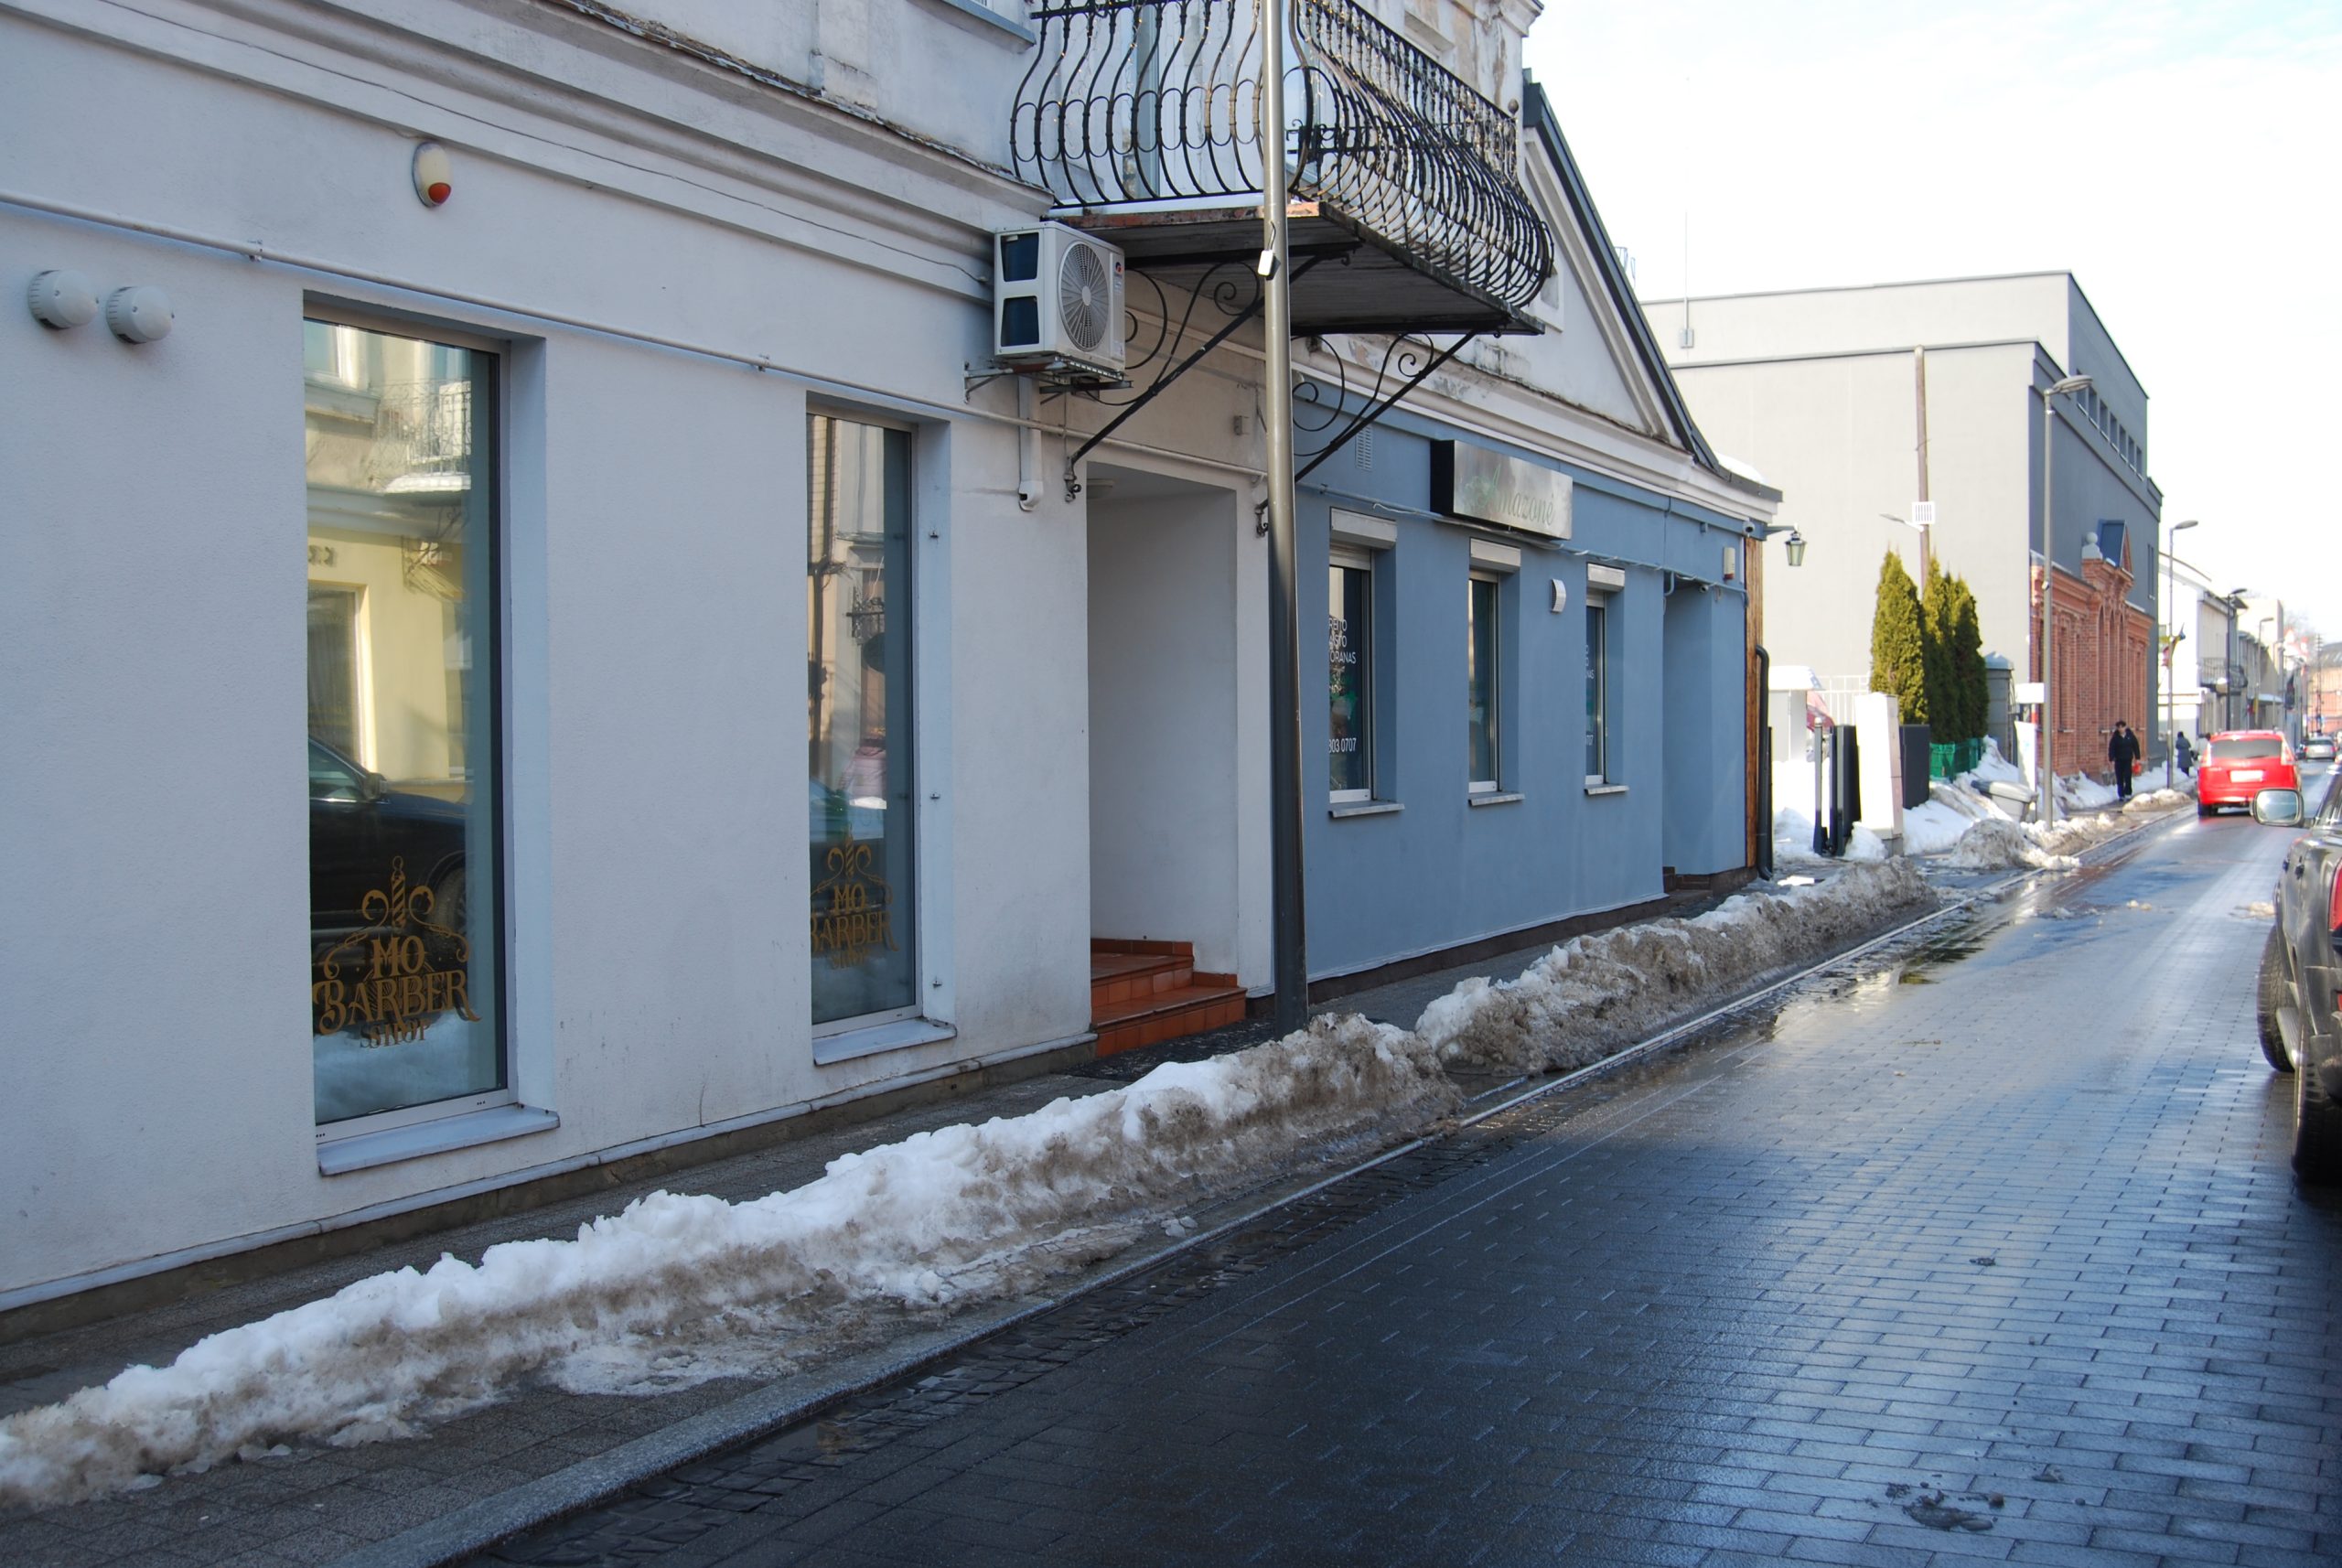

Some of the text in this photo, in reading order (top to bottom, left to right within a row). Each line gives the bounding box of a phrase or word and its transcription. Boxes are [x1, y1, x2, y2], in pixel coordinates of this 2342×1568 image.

[1340, 737, 1357, 752] 0707
[833, 883, 865, 915] MO
[371, 935, 425, 979] MO
[312, 969, 483, 1036] BARBER
